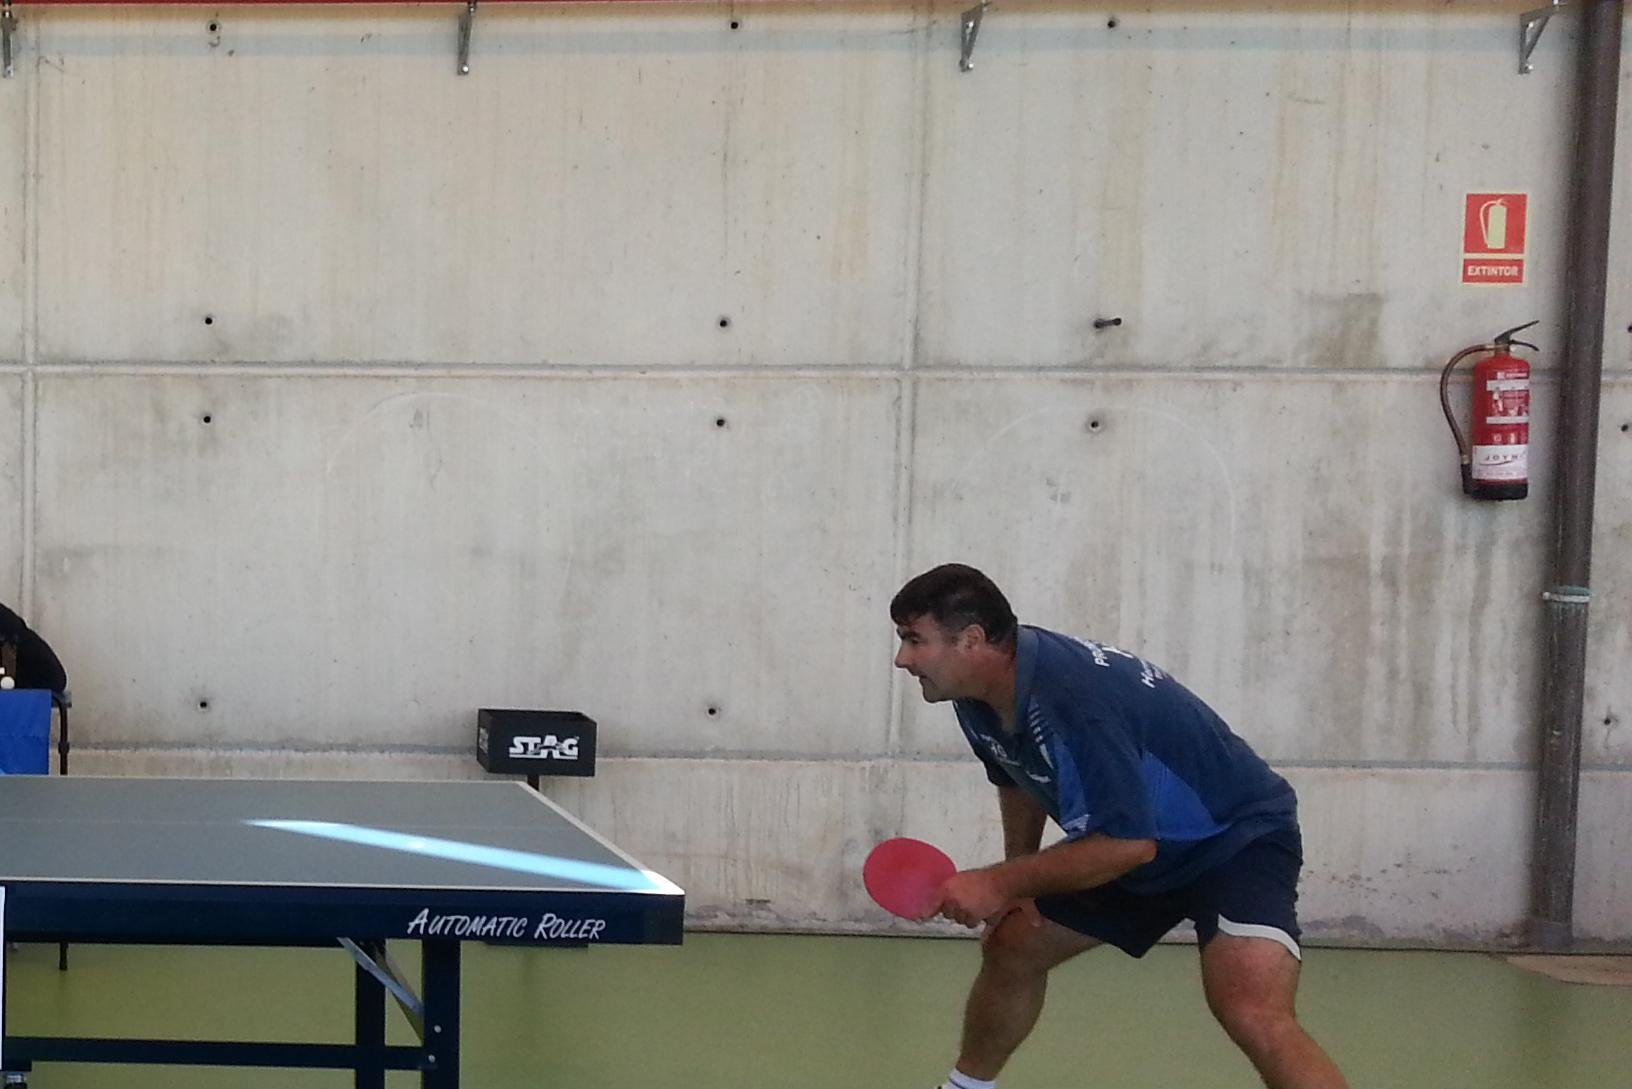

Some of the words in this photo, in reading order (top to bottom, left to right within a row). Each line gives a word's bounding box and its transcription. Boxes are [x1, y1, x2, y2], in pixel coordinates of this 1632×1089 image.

[1467, 265, 1518, 277] EXTINTOR
[509, 735, 579, 760] STAG
[534, 913, 606, 940] ROLLER
